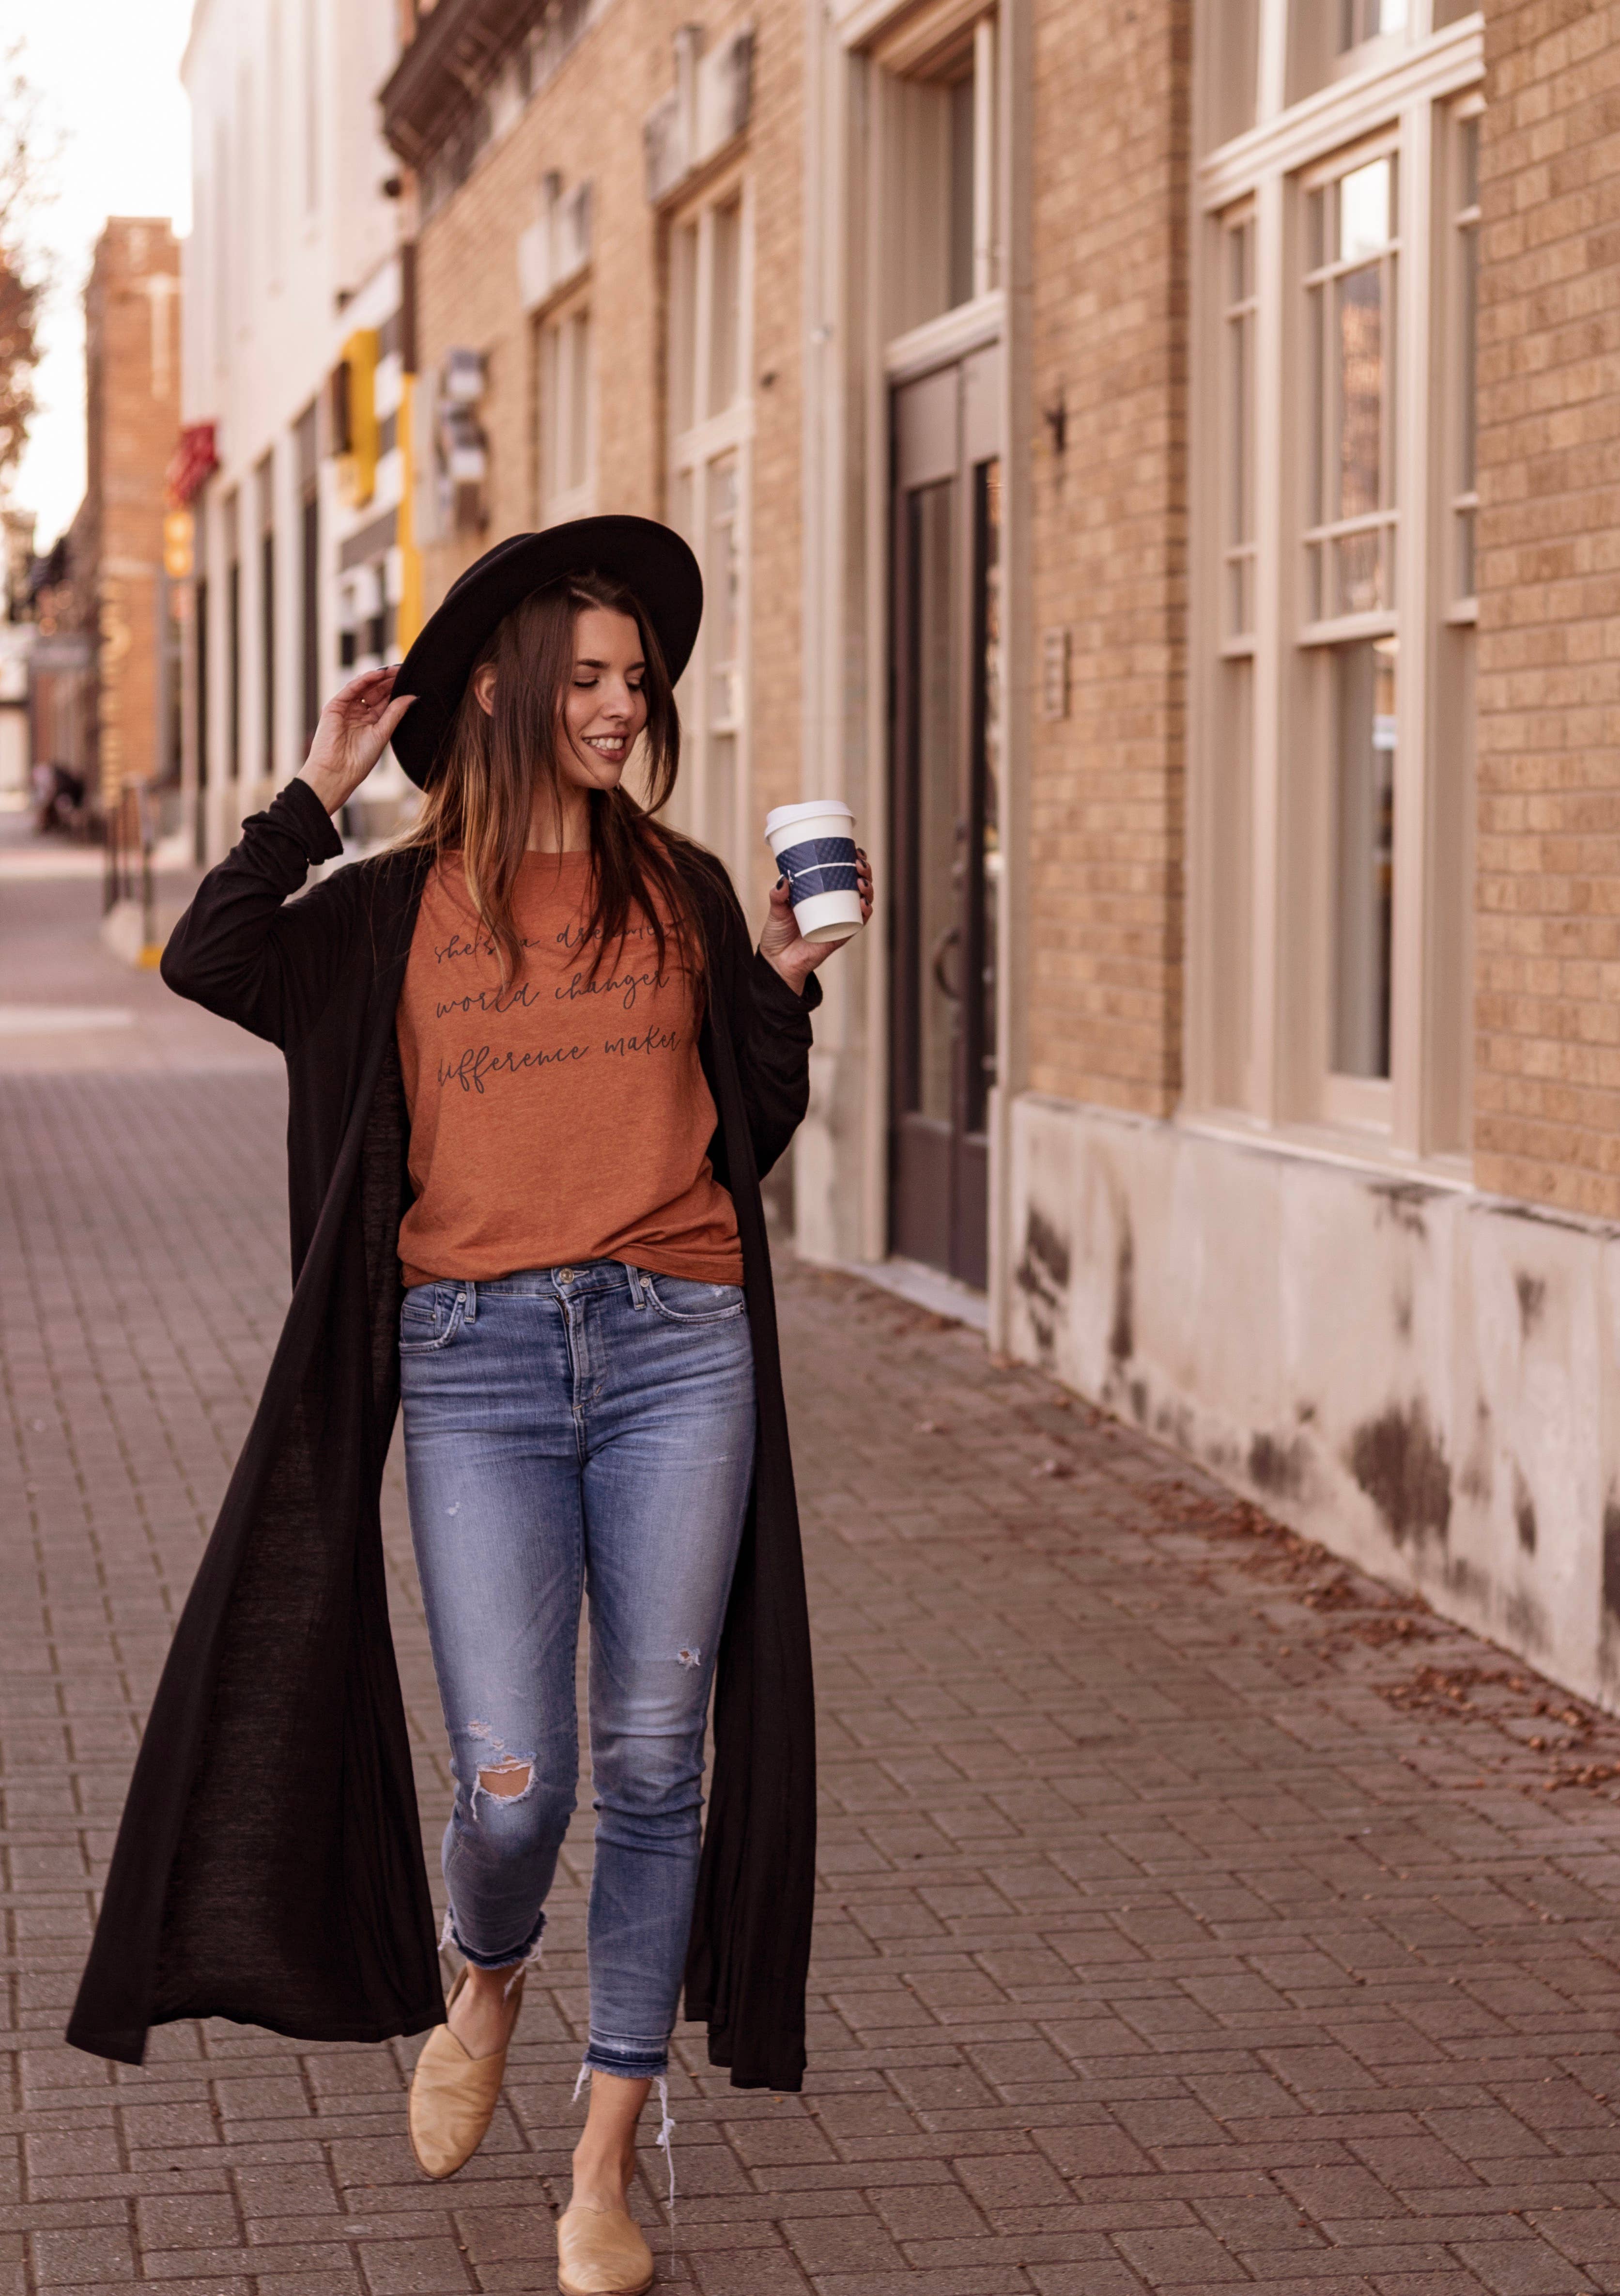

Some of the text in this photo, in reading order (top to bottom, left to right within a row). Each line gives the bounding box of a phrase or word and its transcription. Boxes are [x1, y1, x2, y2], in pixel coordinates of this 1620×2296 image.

[556, 922, 671, 948] dreme
[436, 970, 670, 1018] world changer
[605, 1024, 681, 1056] maker
